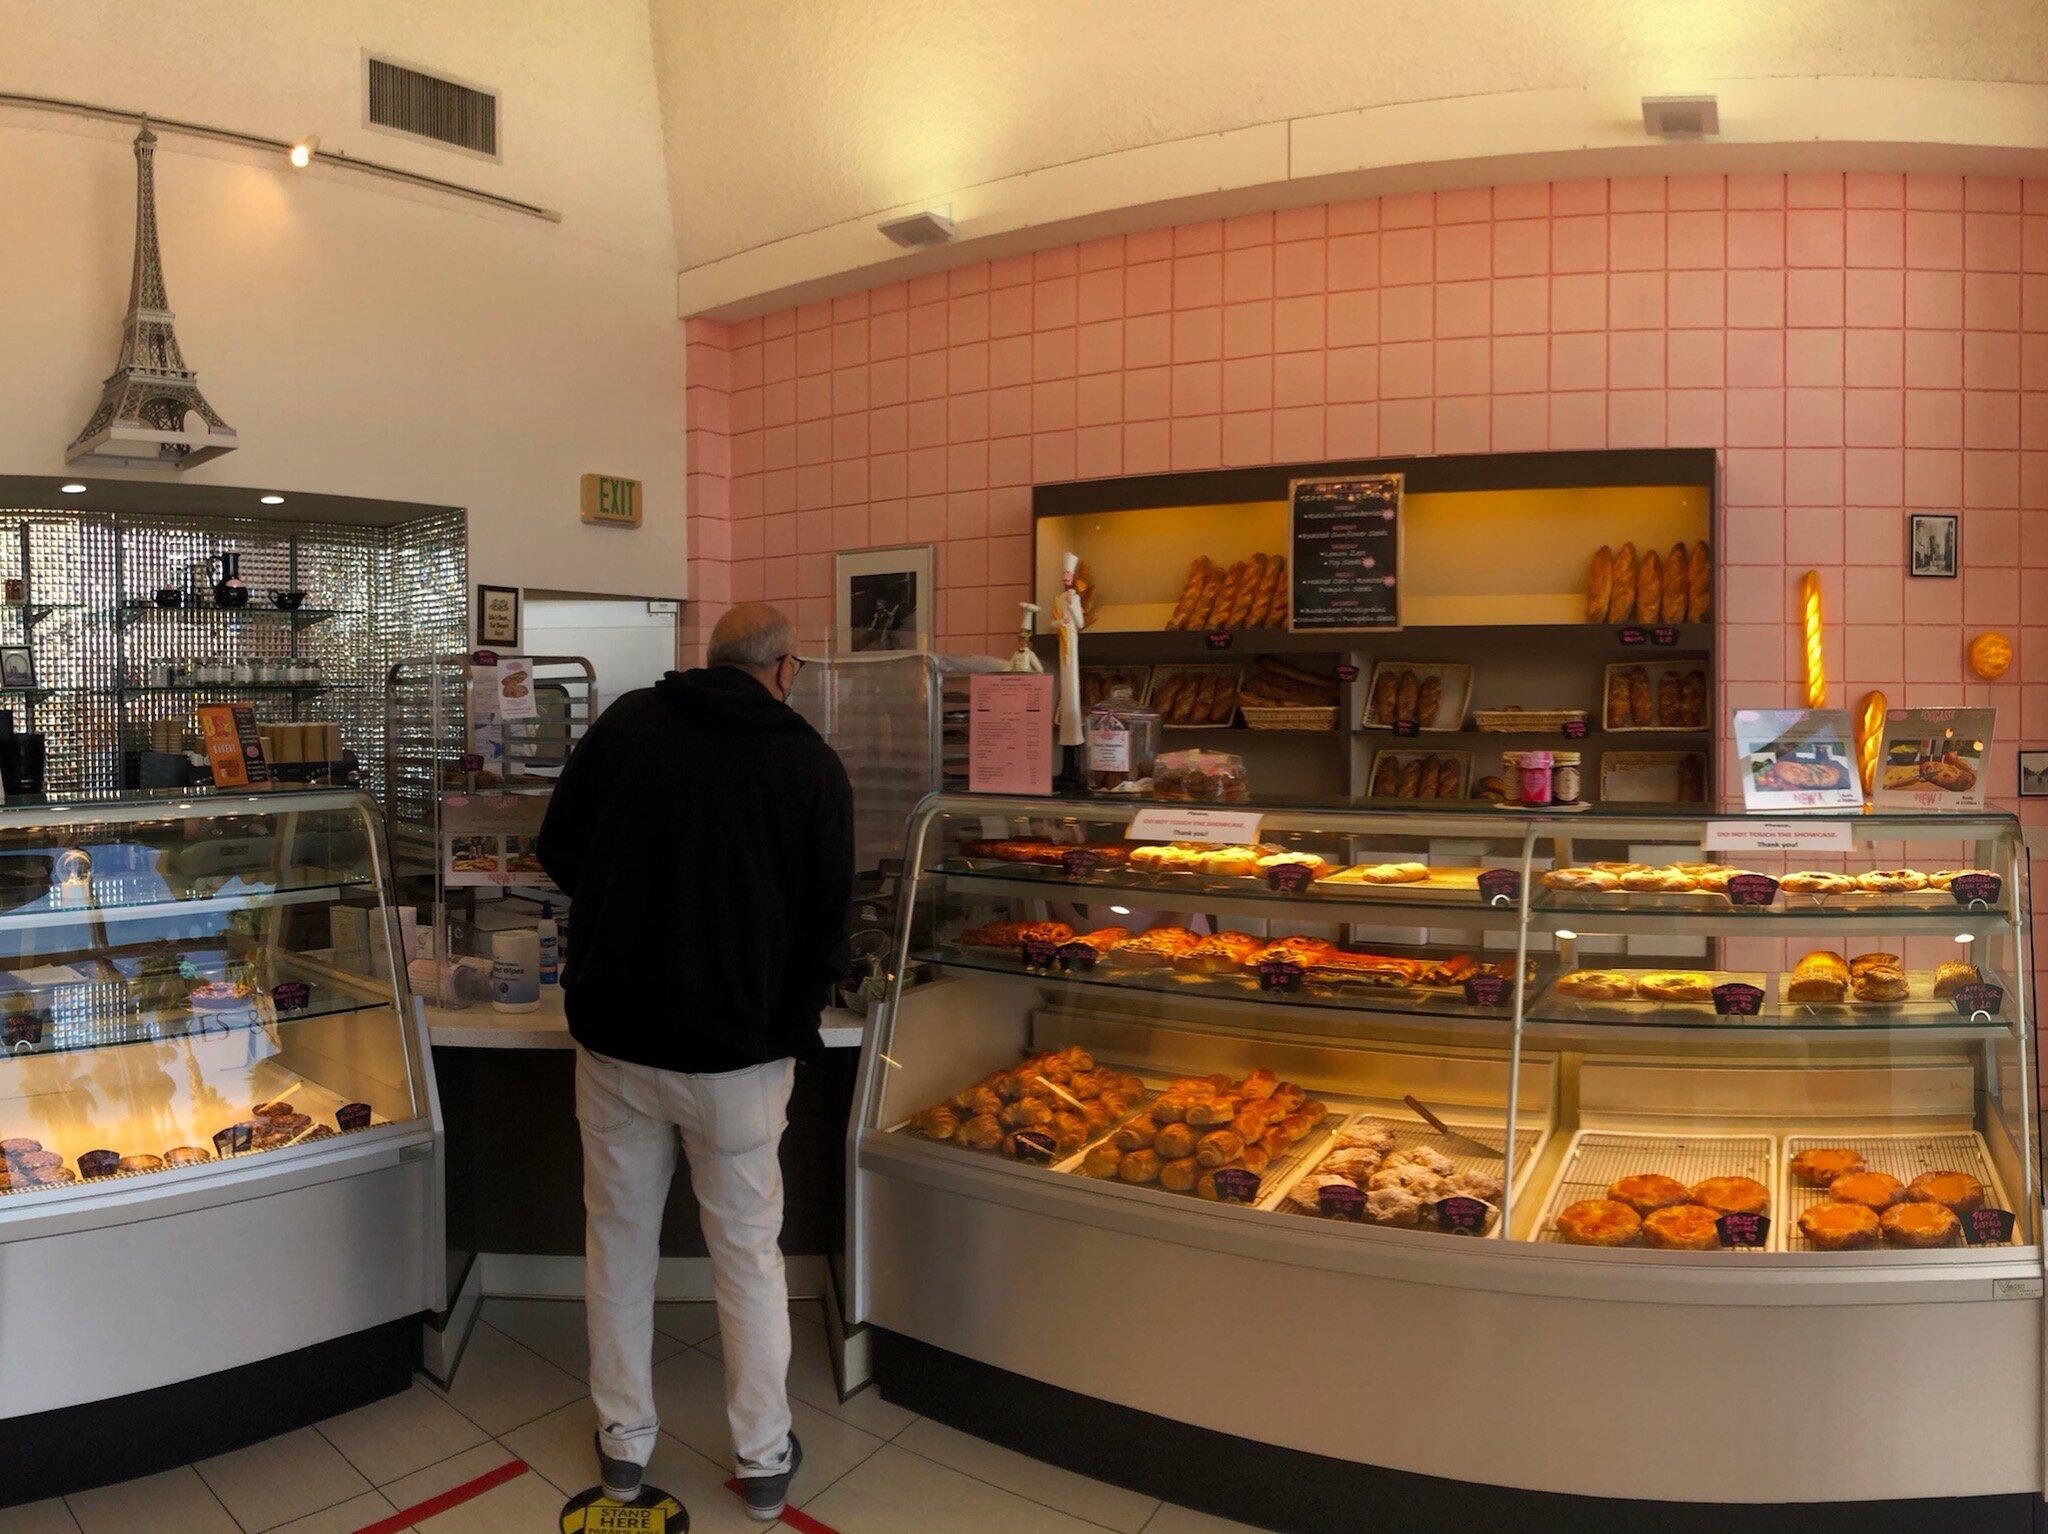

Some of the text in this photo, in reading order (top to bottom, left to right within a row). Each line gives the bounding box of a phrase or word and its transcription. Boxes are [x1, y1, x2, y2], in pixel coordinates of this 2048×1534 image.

[600, 477, 635, 516] EXIT
[1914, 792, 1935, 805] NEW
[1781, 841, 1799, 849] you!
[600, 1508, 652, 1518] STAND
[600, 1517, 651, 1529] HERE
